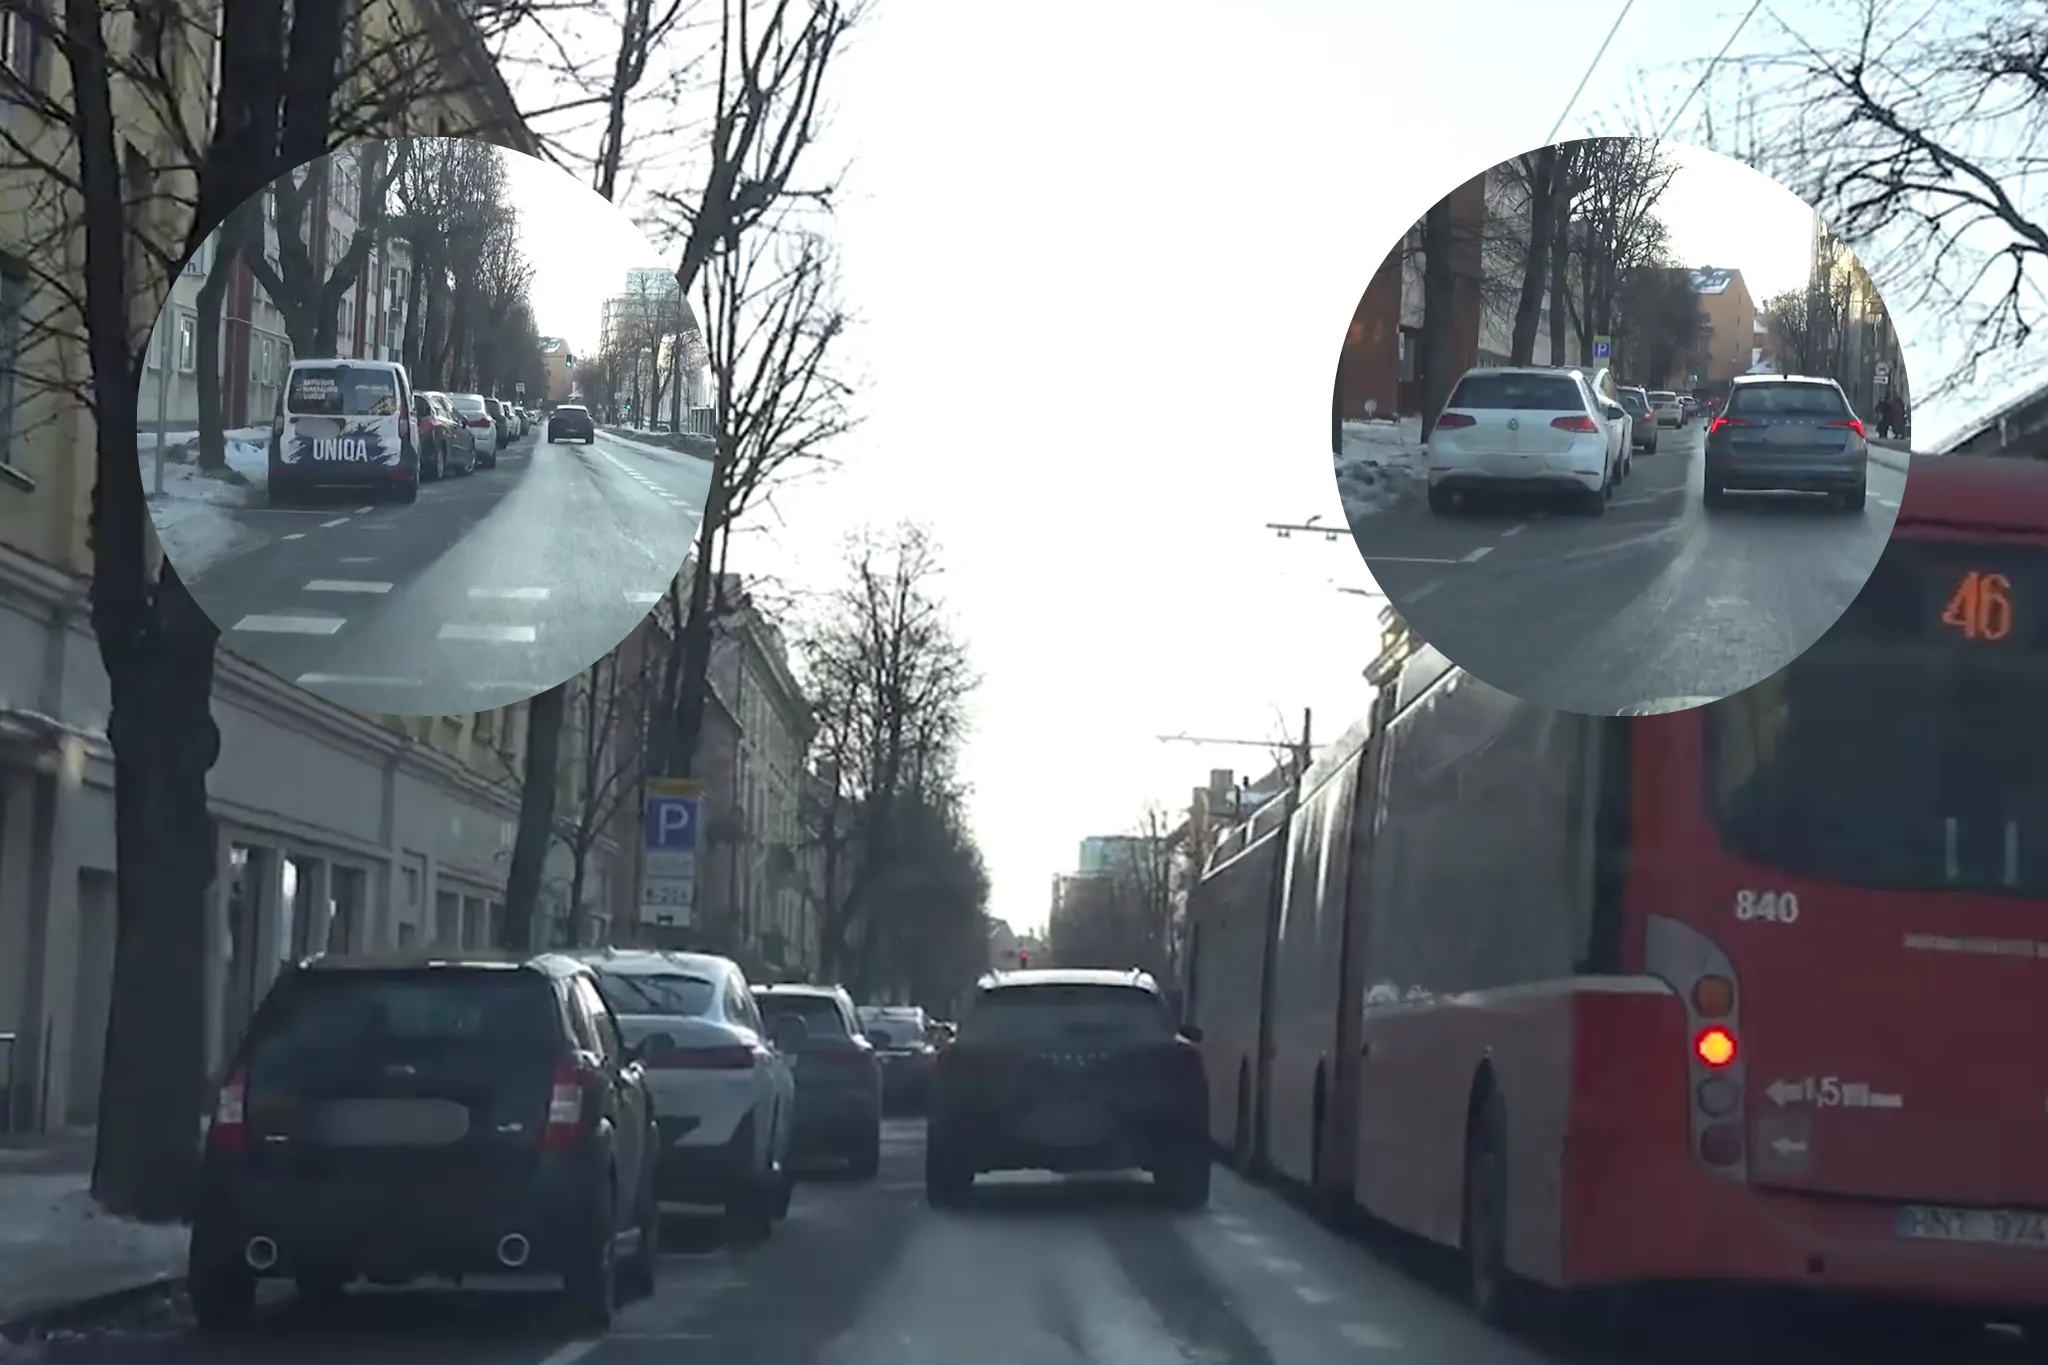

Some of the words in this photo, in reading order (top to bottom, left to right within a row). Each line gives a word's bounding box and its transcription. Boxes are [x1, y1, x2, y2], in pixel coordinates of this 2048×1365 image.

[1597, 343, 1608, 357] P
[313, 438, 368, 462] UNIQA
[1942, 571, 2012, 639] 46
[659, 803, 690, 844] P
[1736, 889, 1799, 923] 840
